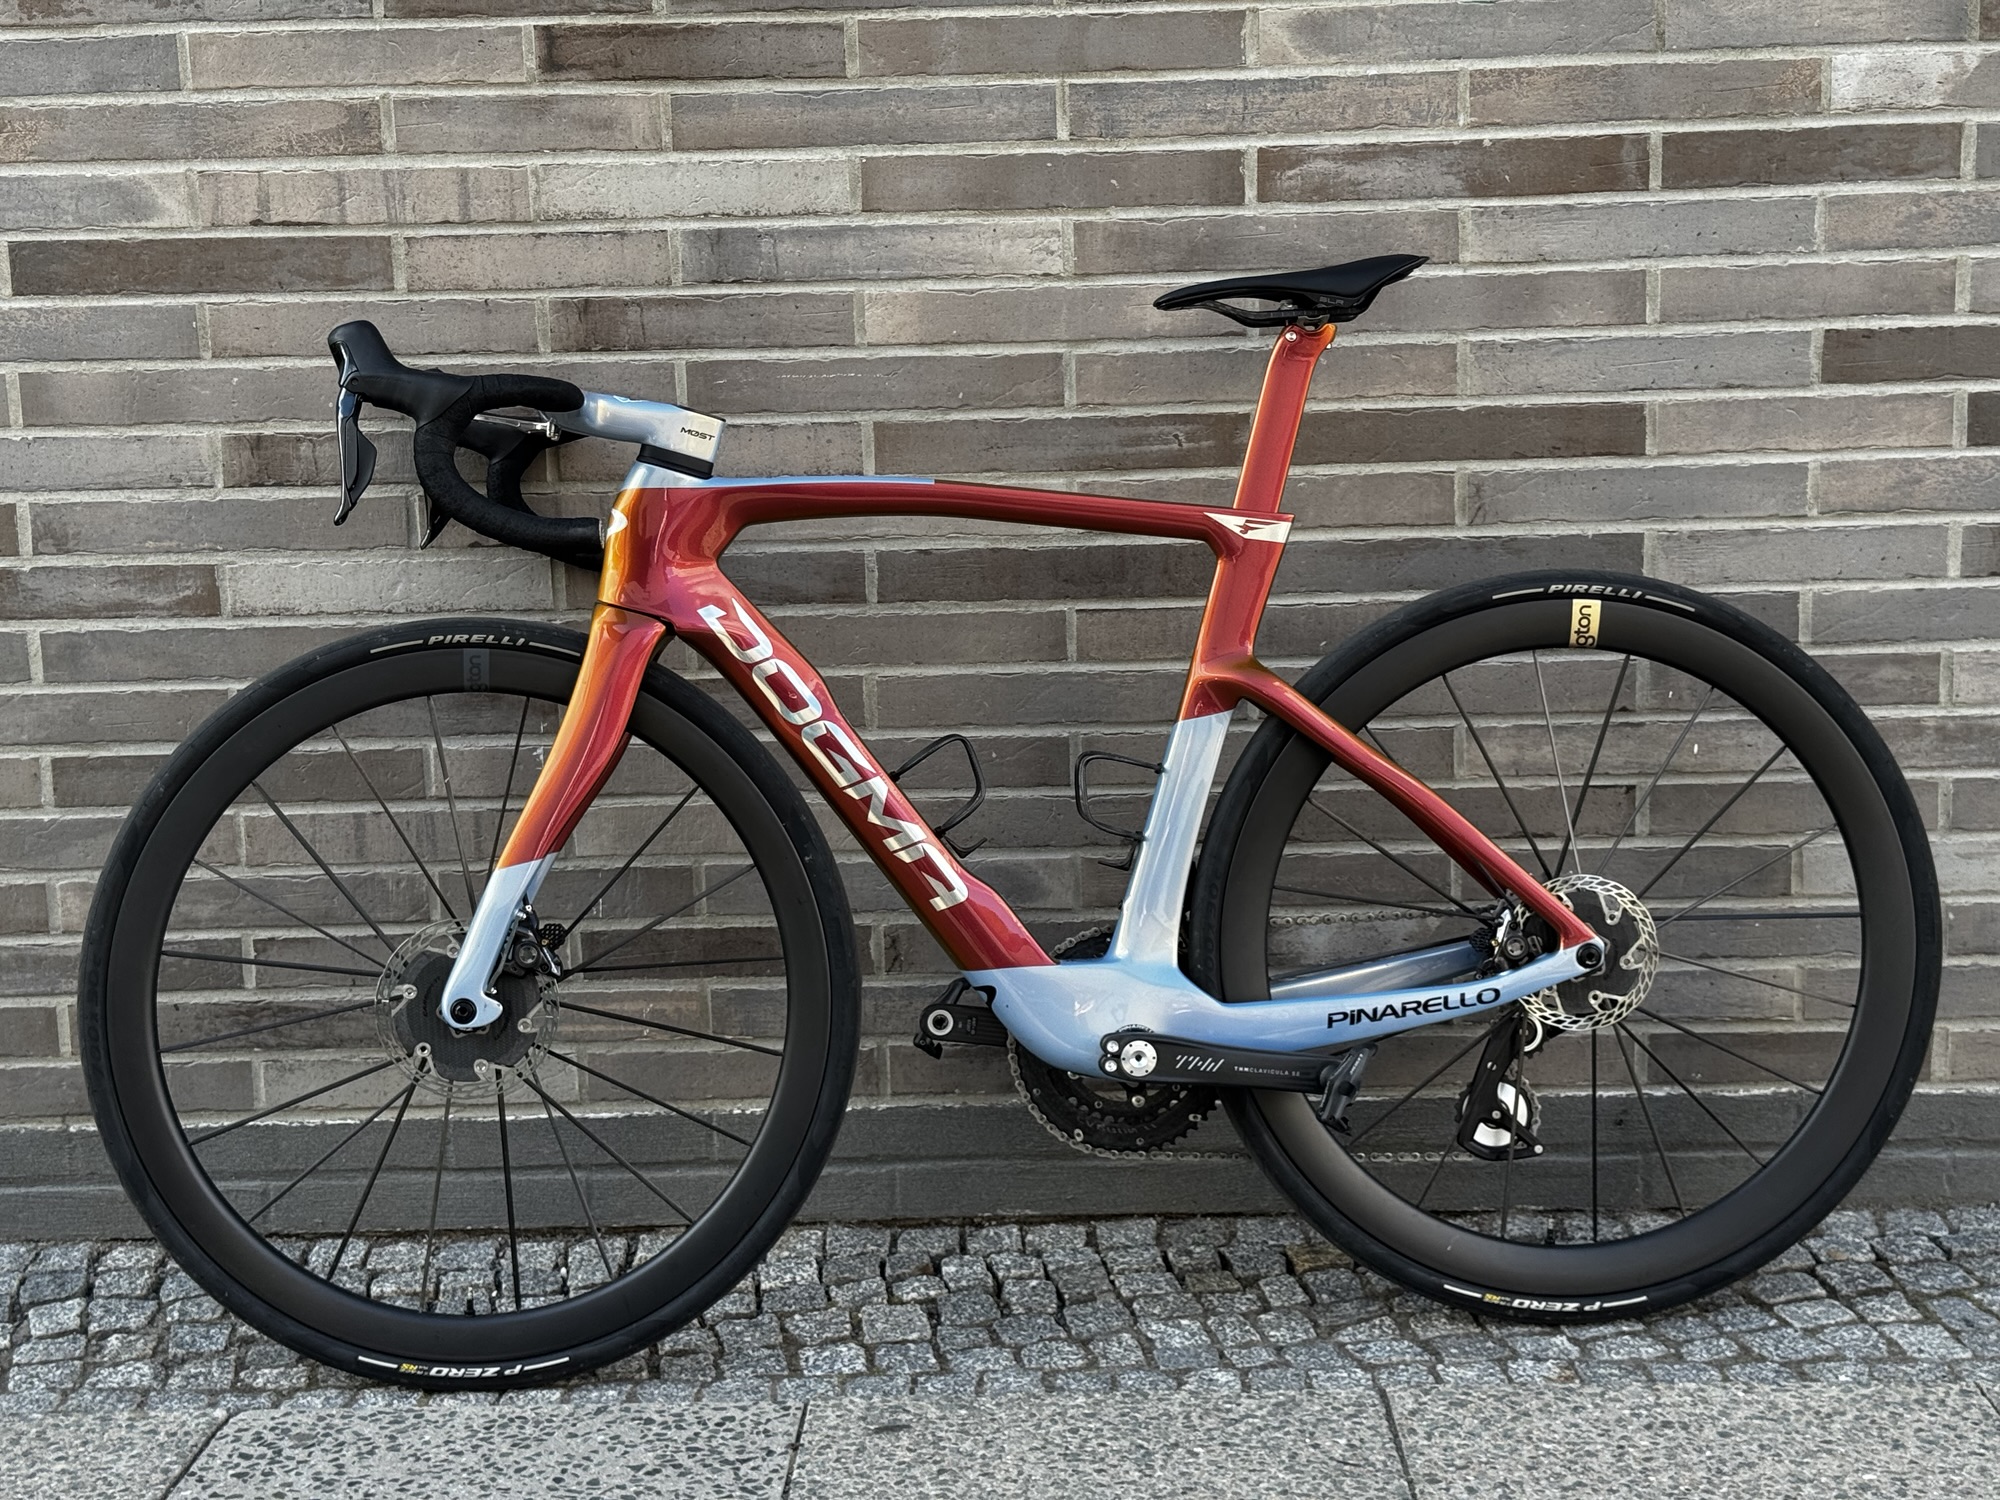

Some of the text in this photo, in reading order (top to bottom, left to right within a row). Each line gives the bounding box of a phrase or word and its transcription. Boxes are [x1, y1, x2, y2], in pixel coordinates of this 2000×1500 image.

[1547, 584, 1642, 599] PIRELLI
[427, 634, 526, 646] PIRELLI
[696, 598, 969, 912] DOGMA
[1512, 1298, 1580, 1312] ZERO
[1583, 1301, 1601, 1311] P
[429, 1366, 501, 1378] ZERO
[504, 1364, 523, 1376] P
